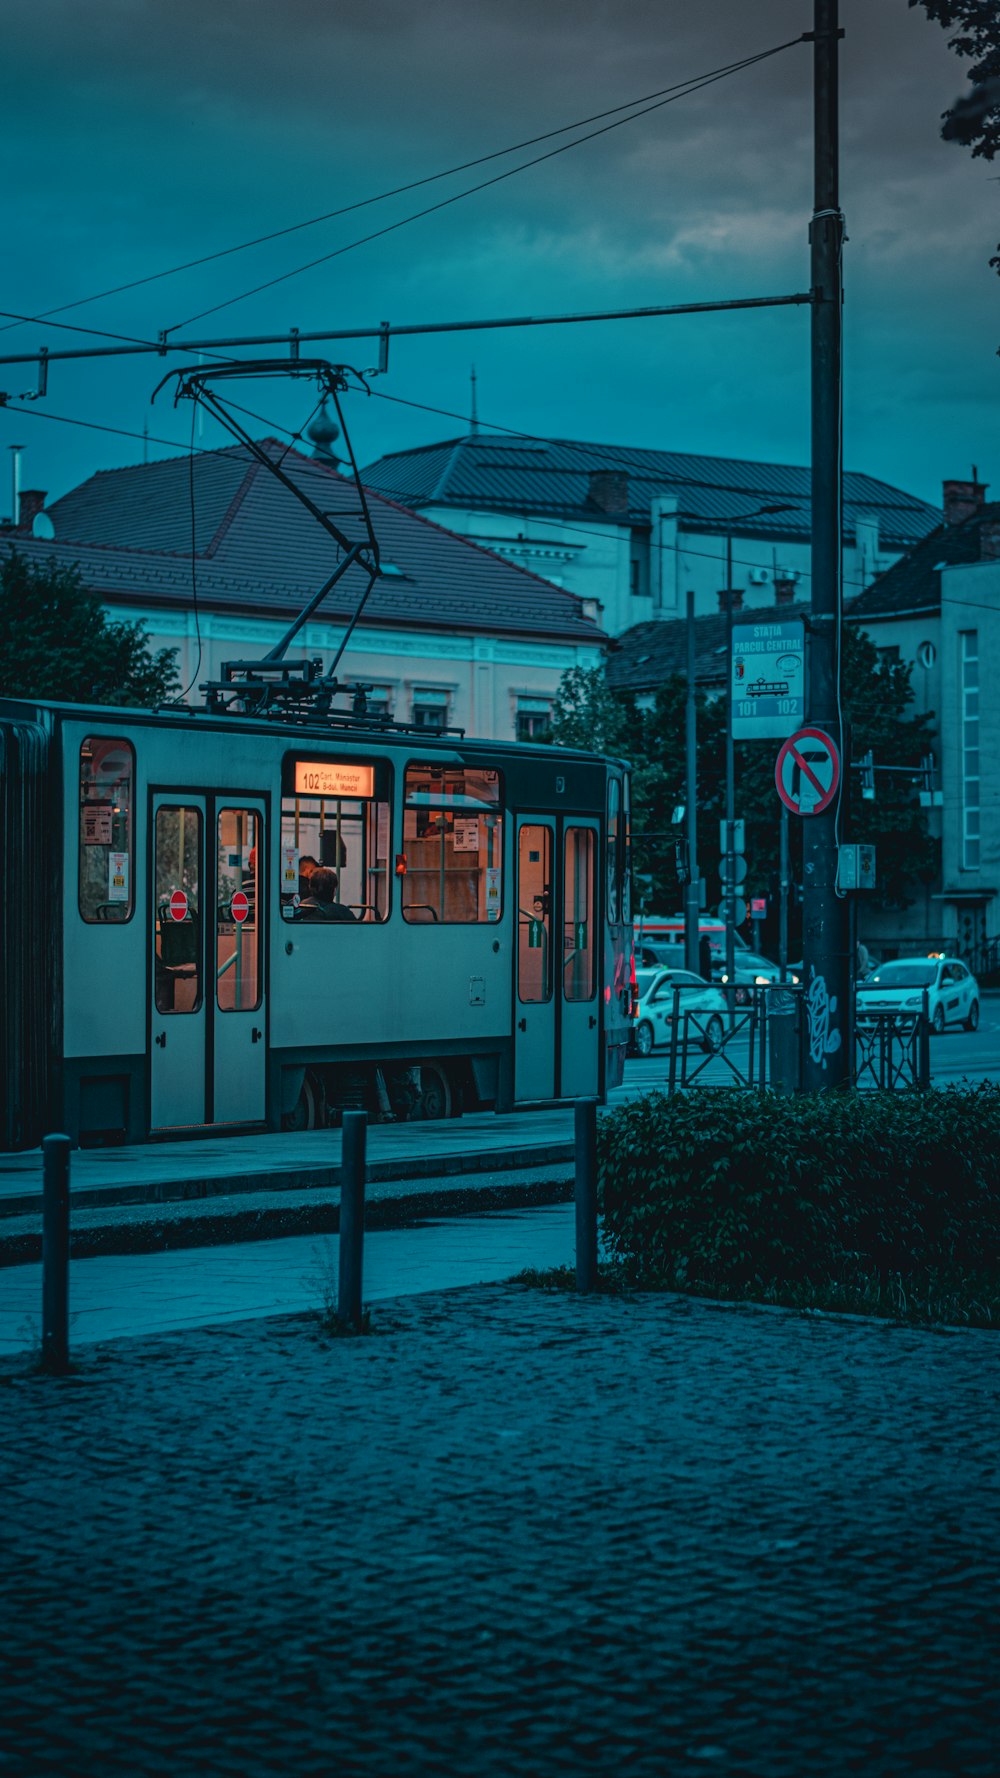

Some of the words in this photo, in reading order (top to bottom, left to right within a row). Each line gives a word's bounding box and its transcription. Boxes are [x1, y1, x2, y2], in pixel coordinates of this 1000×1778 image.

[734, 641, 765, 653] PARCUL
[766, 639, 802, 652] CENTRAL
[738, 701, 757, 717] 101
[777, 699, 797, 715] 102
[303, 773, 320, 789] 102
